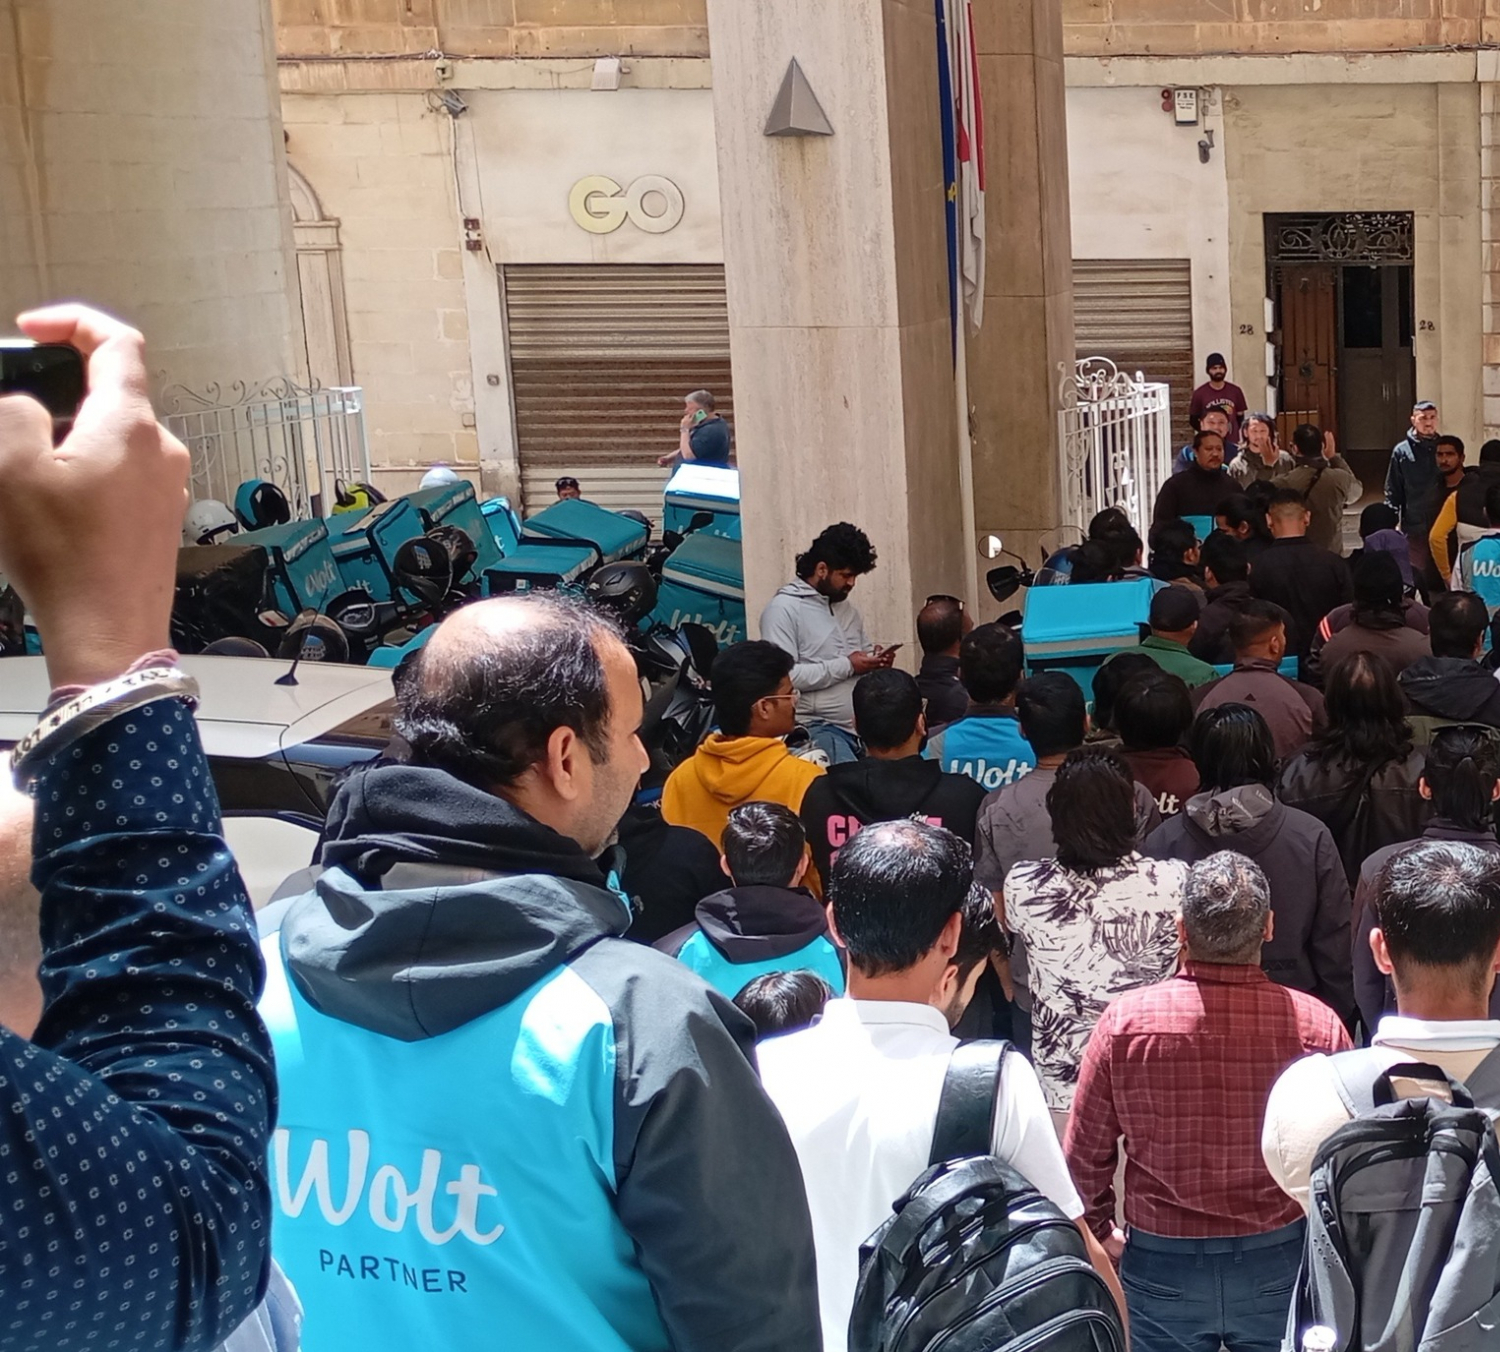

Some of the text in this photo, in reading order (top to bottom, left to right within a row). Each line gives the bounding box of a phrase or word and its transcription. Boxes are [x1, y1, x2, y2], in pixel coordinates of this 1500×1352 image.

[568, 174, 685, 235] GO
[1239, 324, 1254, 335] 28
[1419, 319, 1436, 331] 28
[950, 758, 1032, 789] Wolt
[274, 1128, 505, 1246] Wolt
[319, 1248, 468, 1294] PARTNER
